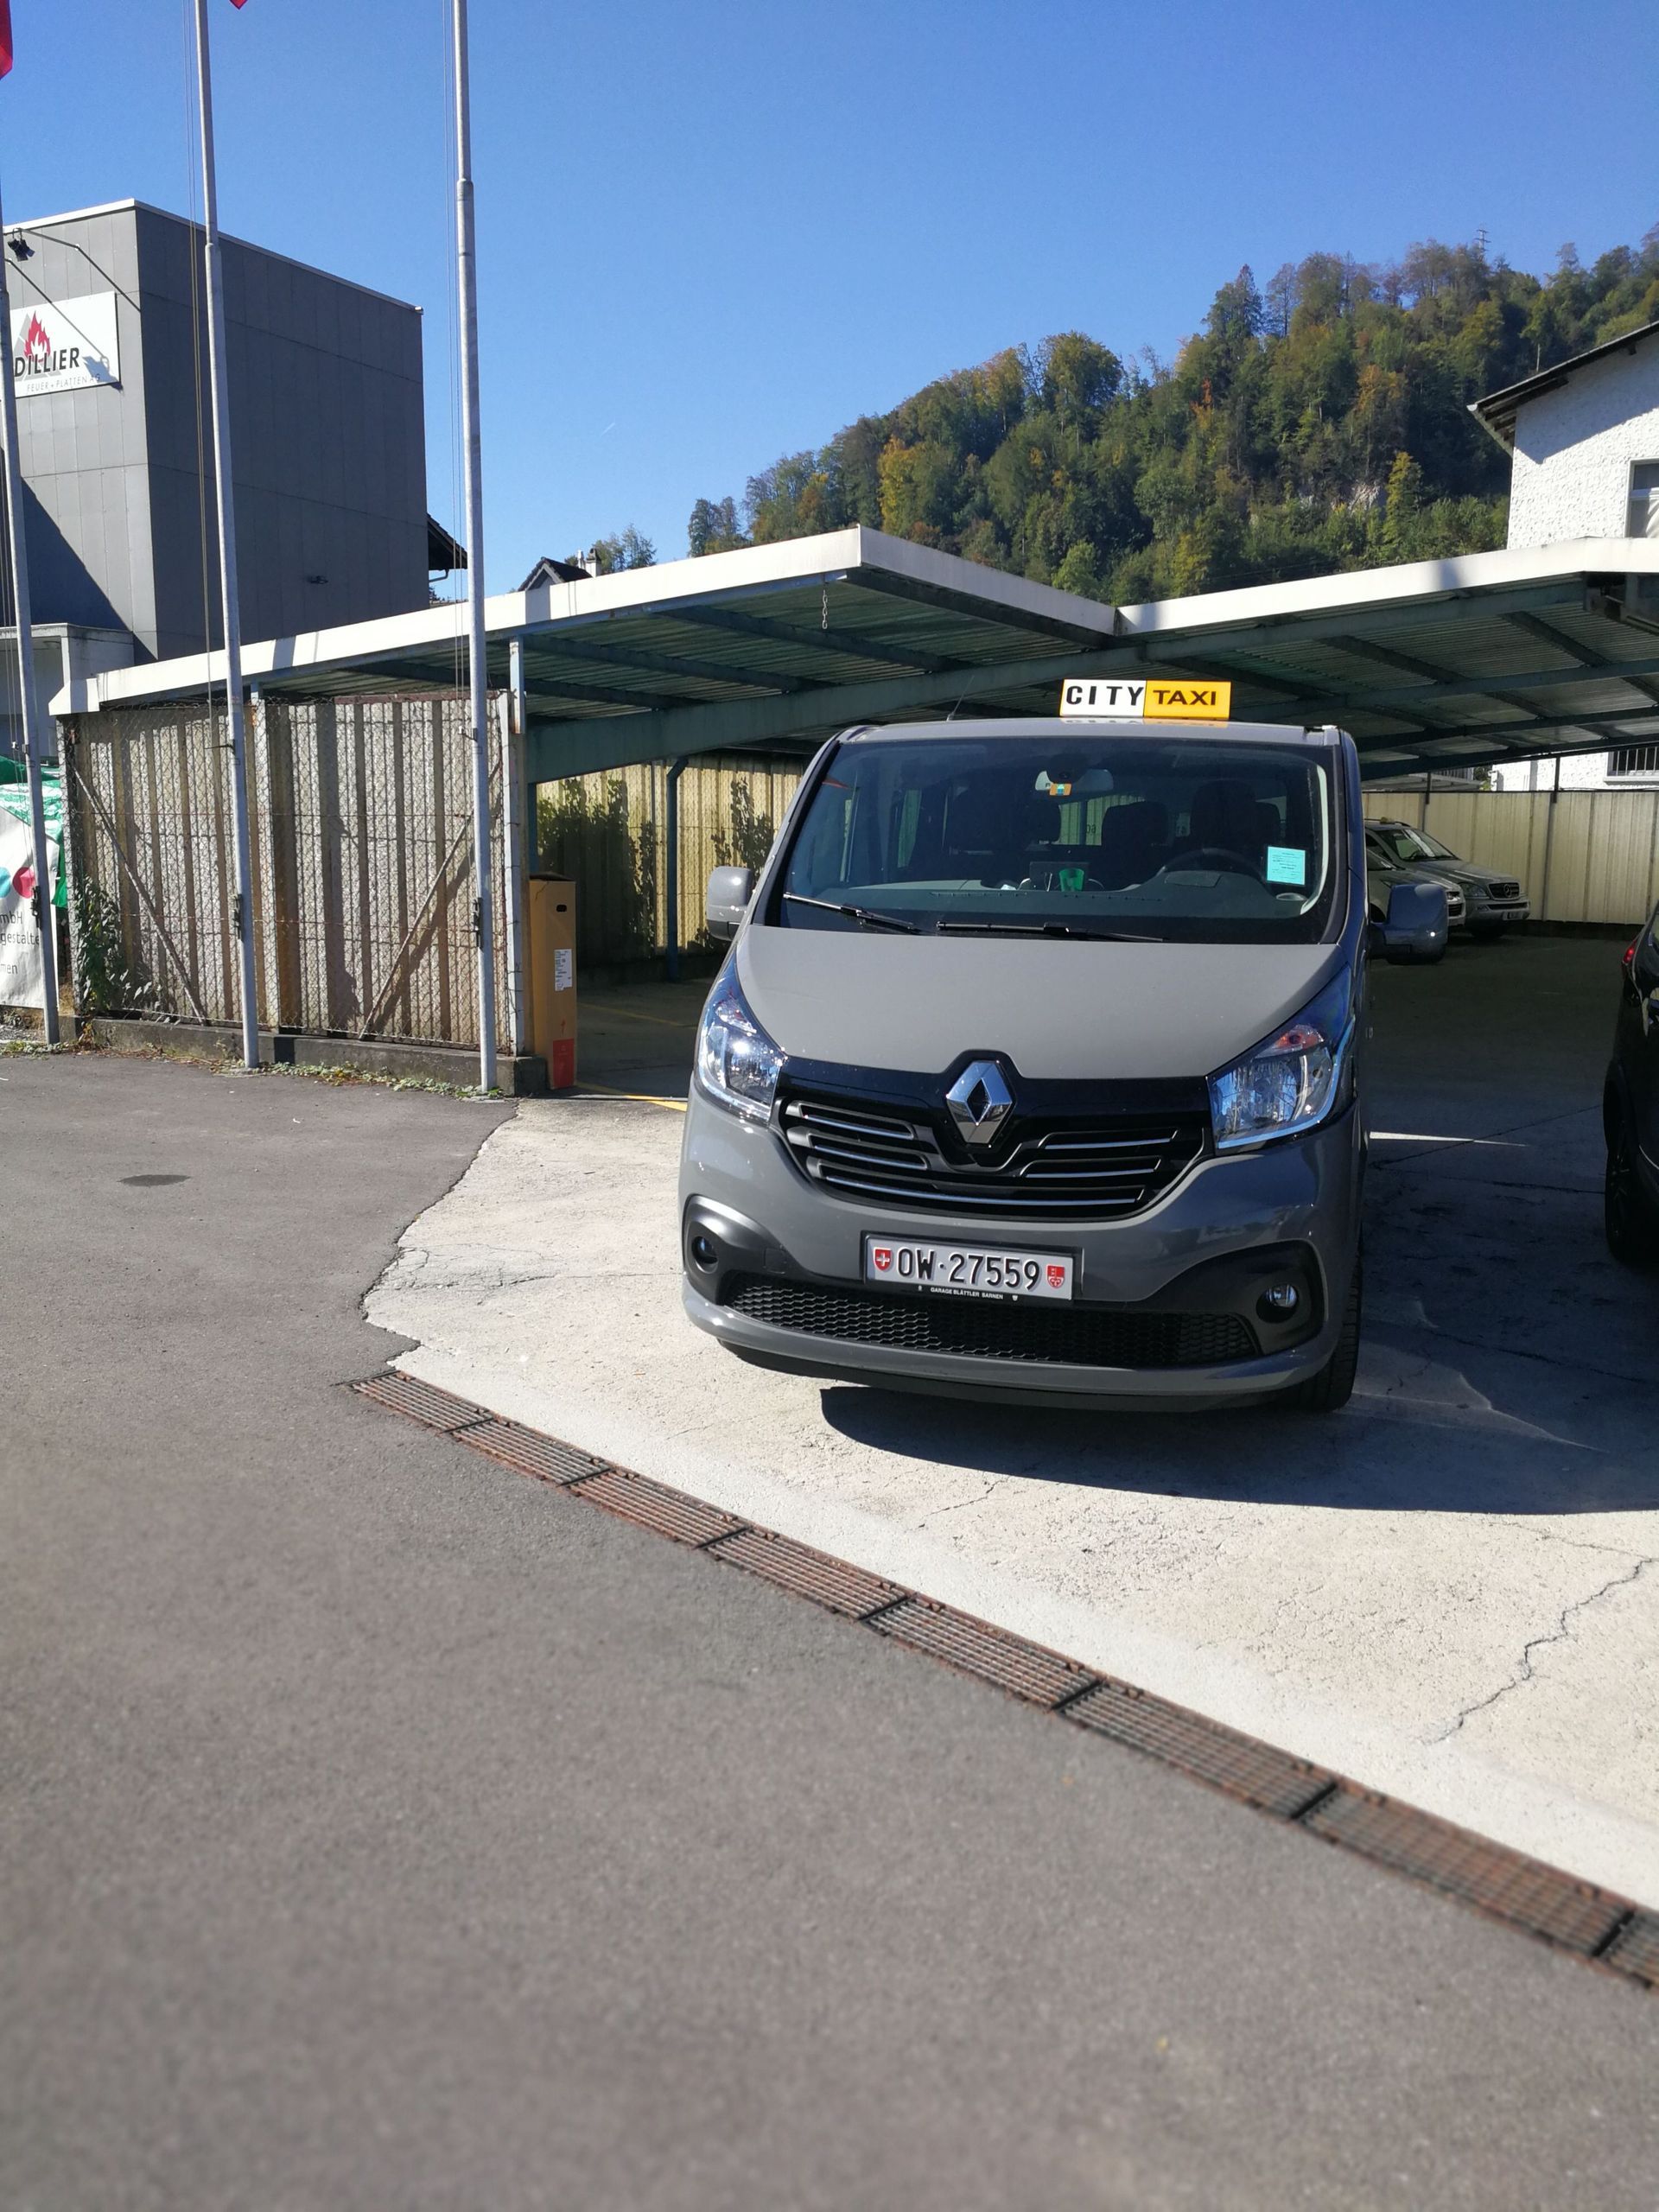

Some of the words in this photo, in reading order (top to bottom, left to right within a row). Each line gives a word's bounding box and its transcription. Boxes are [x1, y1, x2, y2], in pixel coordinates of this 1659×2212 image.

[14, 346, 79, 378] DILLIER
[27, 381, 49, 392] FEUER
[56, 376, 87, 388] PLATTEN
[1065, 685, 1144, 706] CITY
[1153, 690, 1217, 706] TAXI
[0, 910, 23, 925] mbH
